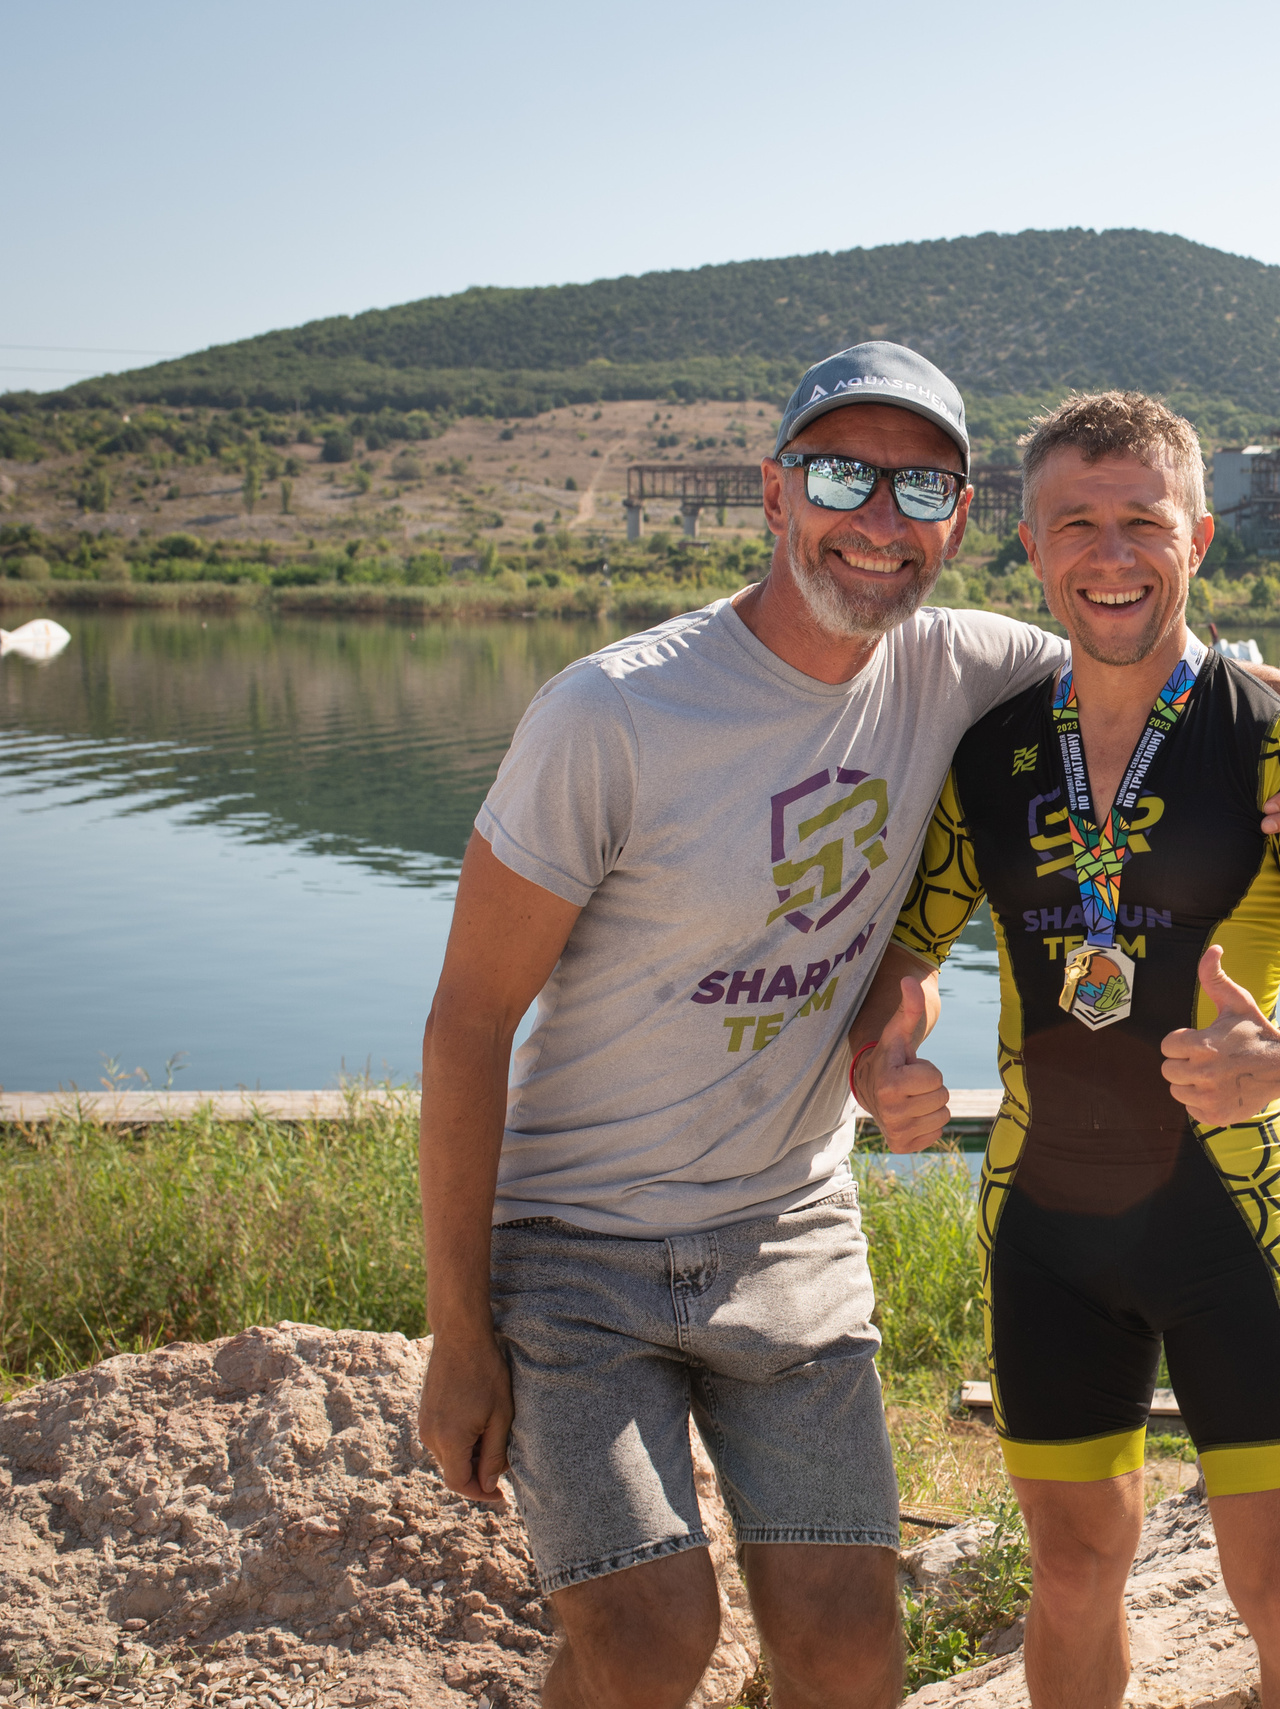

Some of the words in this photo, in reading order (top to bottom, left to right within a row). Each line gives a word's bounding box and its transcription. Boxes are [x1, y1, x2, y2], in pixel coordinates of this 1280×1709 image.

[1057, 721, 1078, 733] 2023
[1148, 717, 1172, 731] 2023
[1059, 734, 1072, 774] СЕВАСТОПОЛЯ
[1067, 733, 1087, 793] ТРИАТЛОНУ
[1115, 769, 1135, 806] ЧЕМПИОНАТ
[1130, 727, 1154, 769] СЕВАСТОПОЛЯ
[1129, 730, 1166, 790] ТРИАТЛОНУ
[1066, 775, 1078, 811] ЧЕМПИОНАТ
[1077, 795, 1090, 810] ПО
[1122, 792, 1137, 808] ПО
[1022, 904, 1172, 932] SHAUN
[1043, 934, 1146, 961] TEM
[723, 976, 839, 1053] TEM
